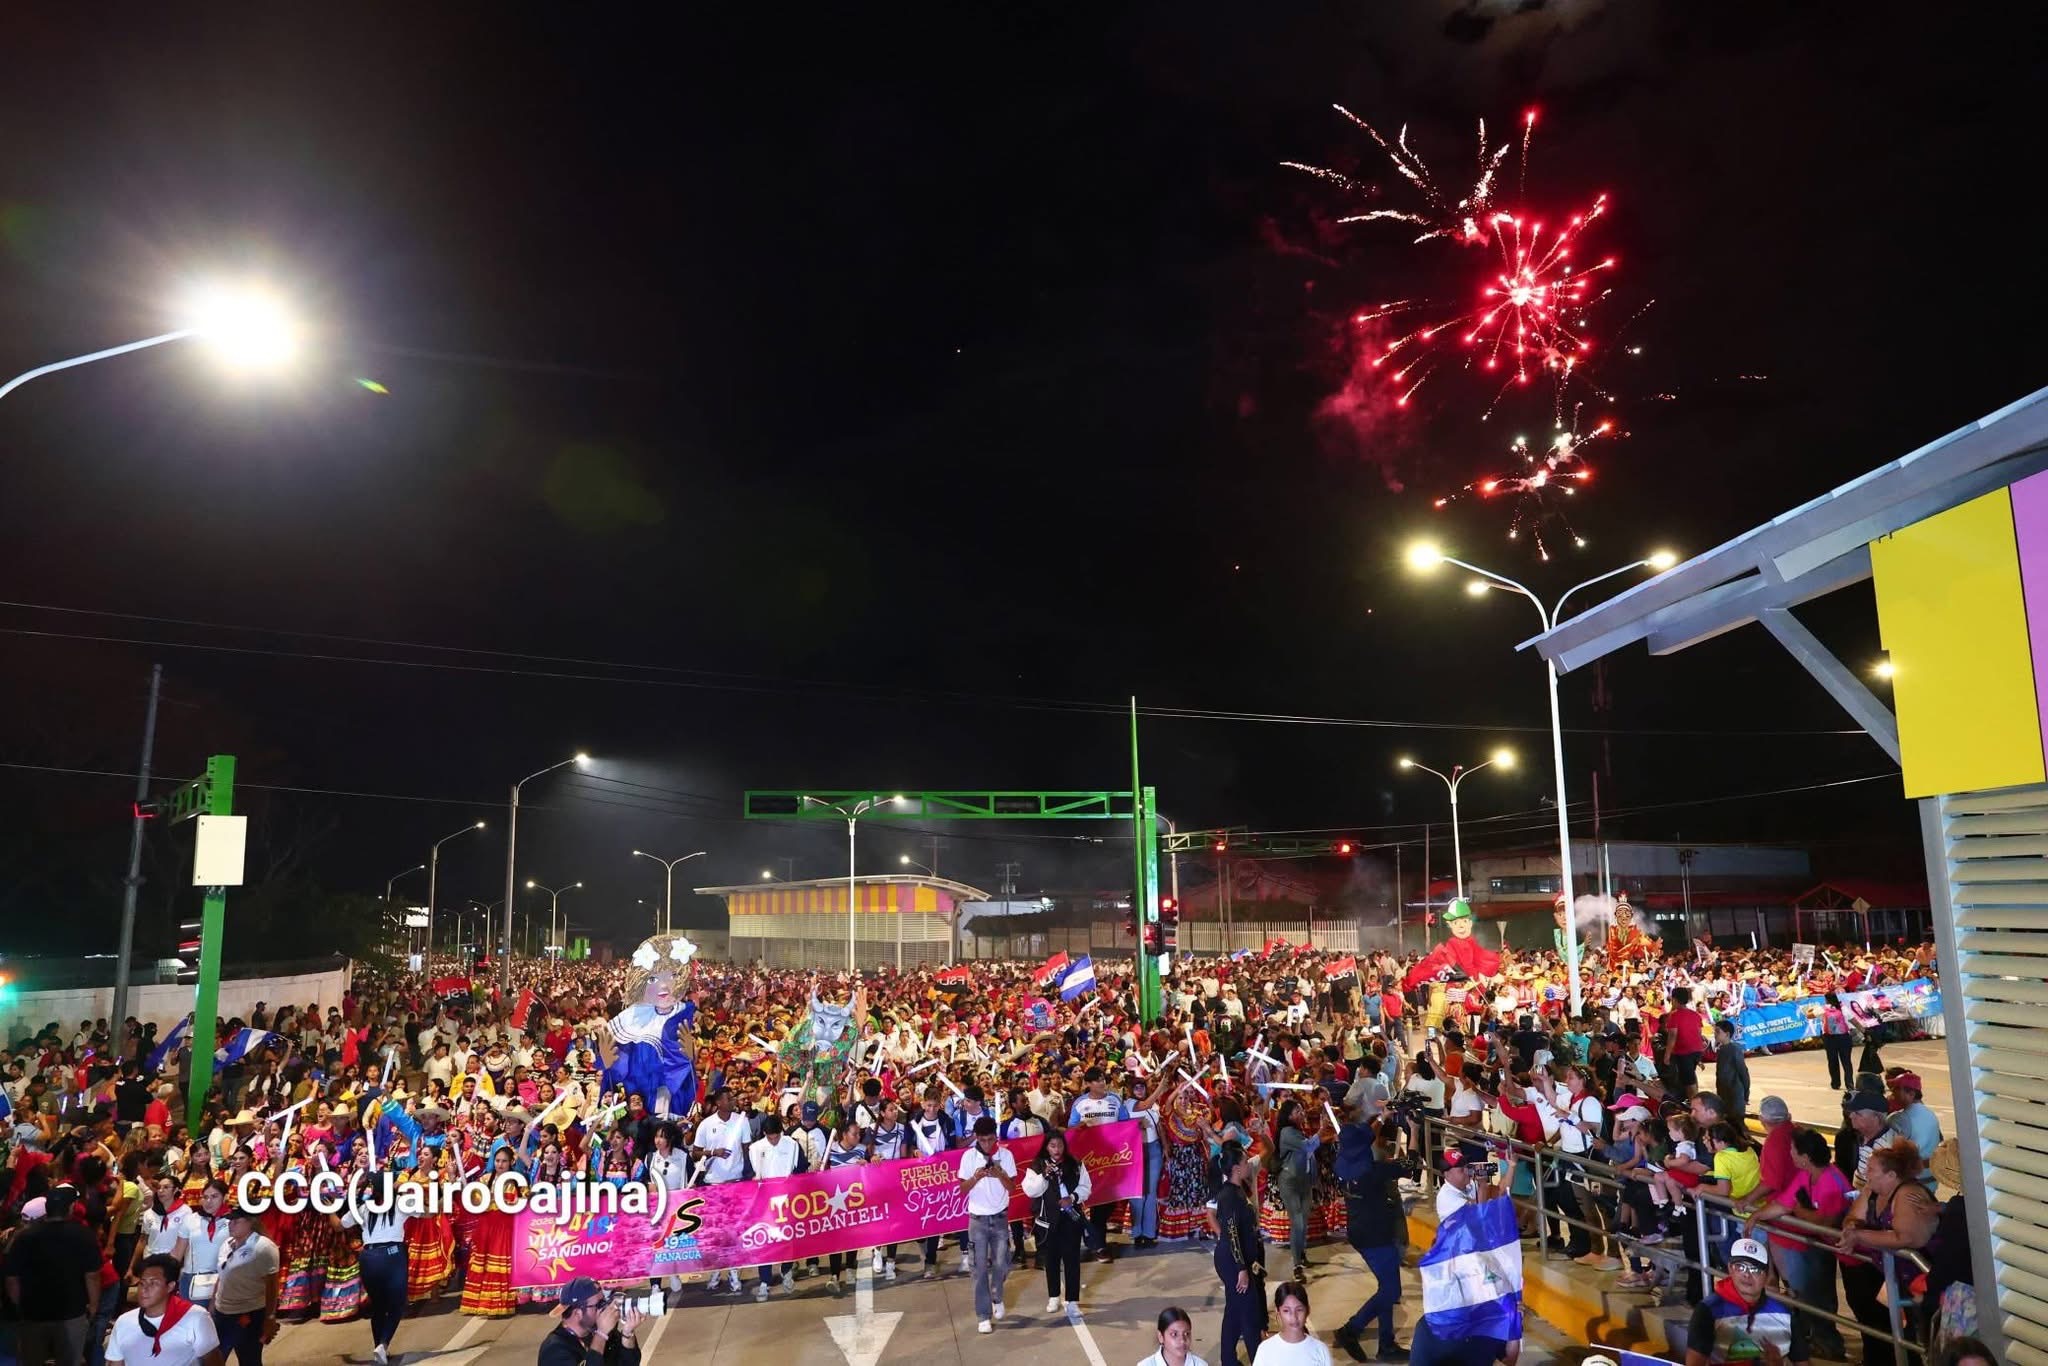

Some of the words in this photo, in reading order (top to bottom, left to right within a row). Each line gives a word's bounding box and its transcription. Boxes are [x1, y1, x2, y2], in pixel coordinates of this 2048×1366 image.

[901, 1161, 949, 1181] PUEBLO
[901, 1170, 959, 1192] VICTORI
[904, 1184, 962, 1212] Siemp
[741, 1222, 806, 1248] SOMOS
[809, 1202, 890, 1235] DANIEL!
[538, 1241, 613, 1260] SANDINO!
[654, 1250, 702, 1264] MANAGUA
